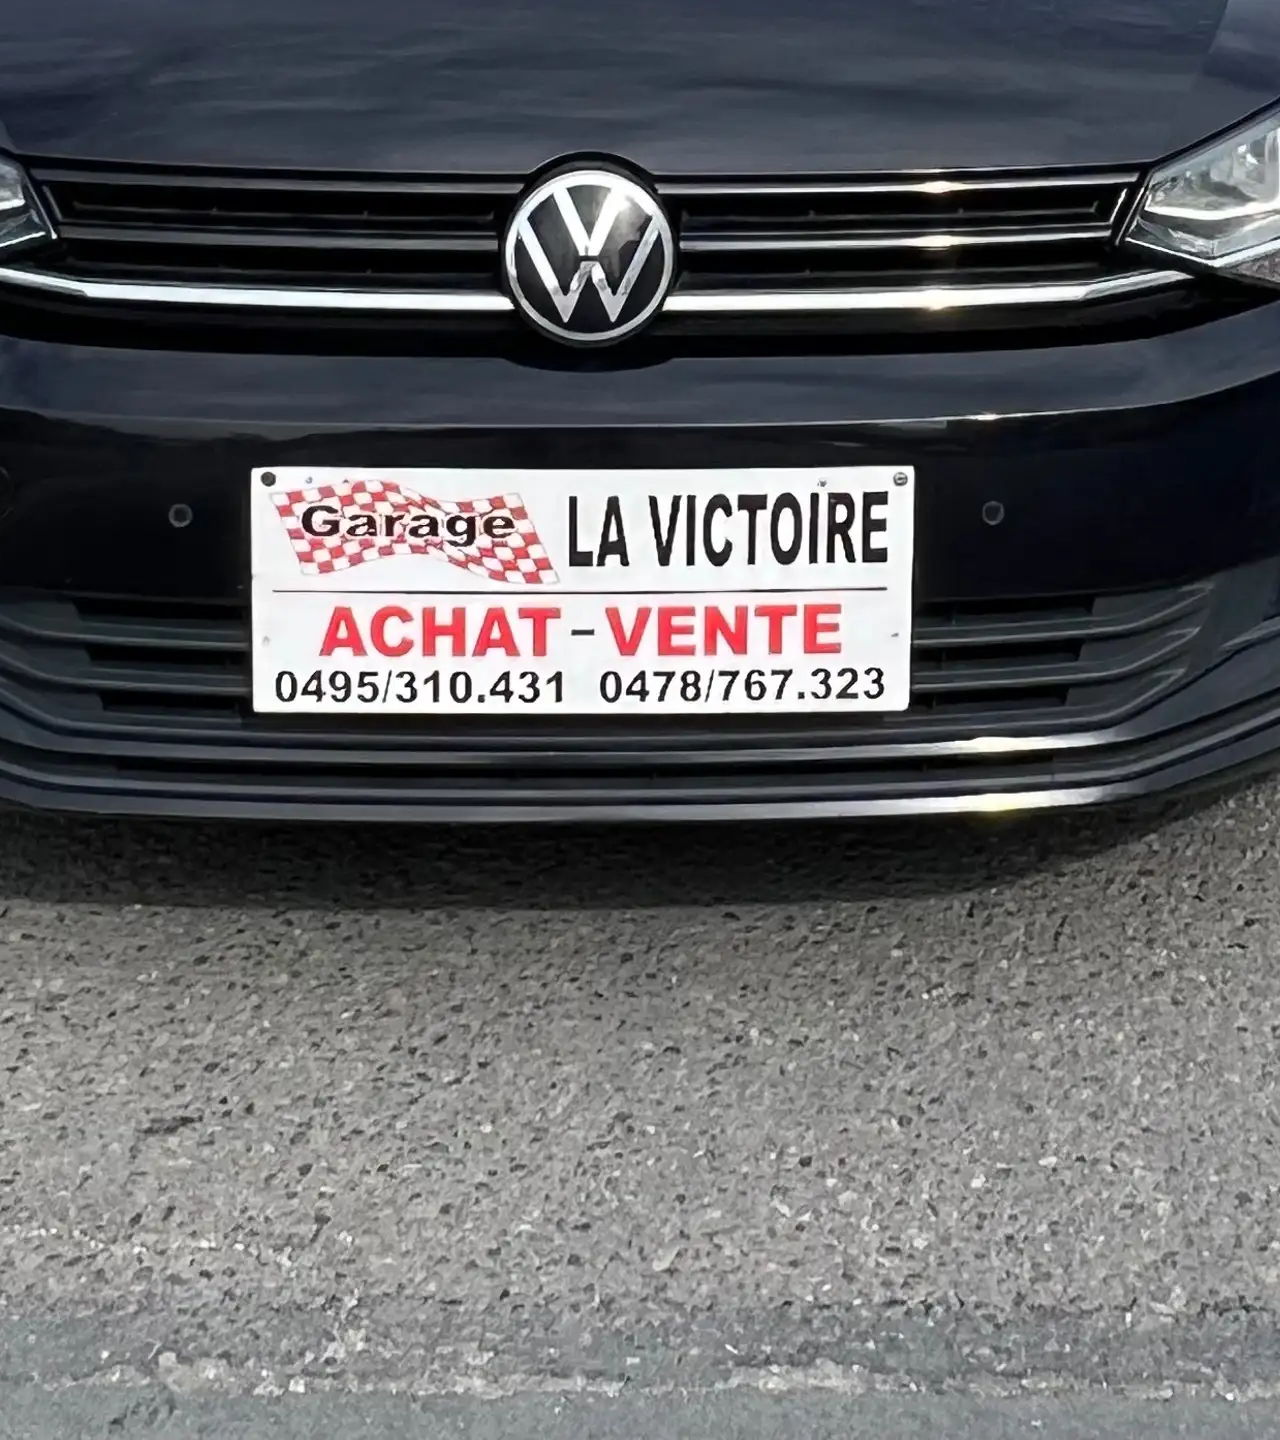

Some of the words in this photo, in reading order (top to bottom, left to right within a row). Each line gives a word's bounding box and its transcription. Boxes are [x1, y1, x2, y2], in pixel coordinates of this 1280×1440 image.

[508, 171, 673, 339] VW
[301, 505, 517, 548] Garage
[568, 495, 630, 567] LA
[648, 492, 889, 566] VICTOIRE
[275, 670, 565, 704] 0495/310.431
[599, 667, 886, 703] 0478/767.323
